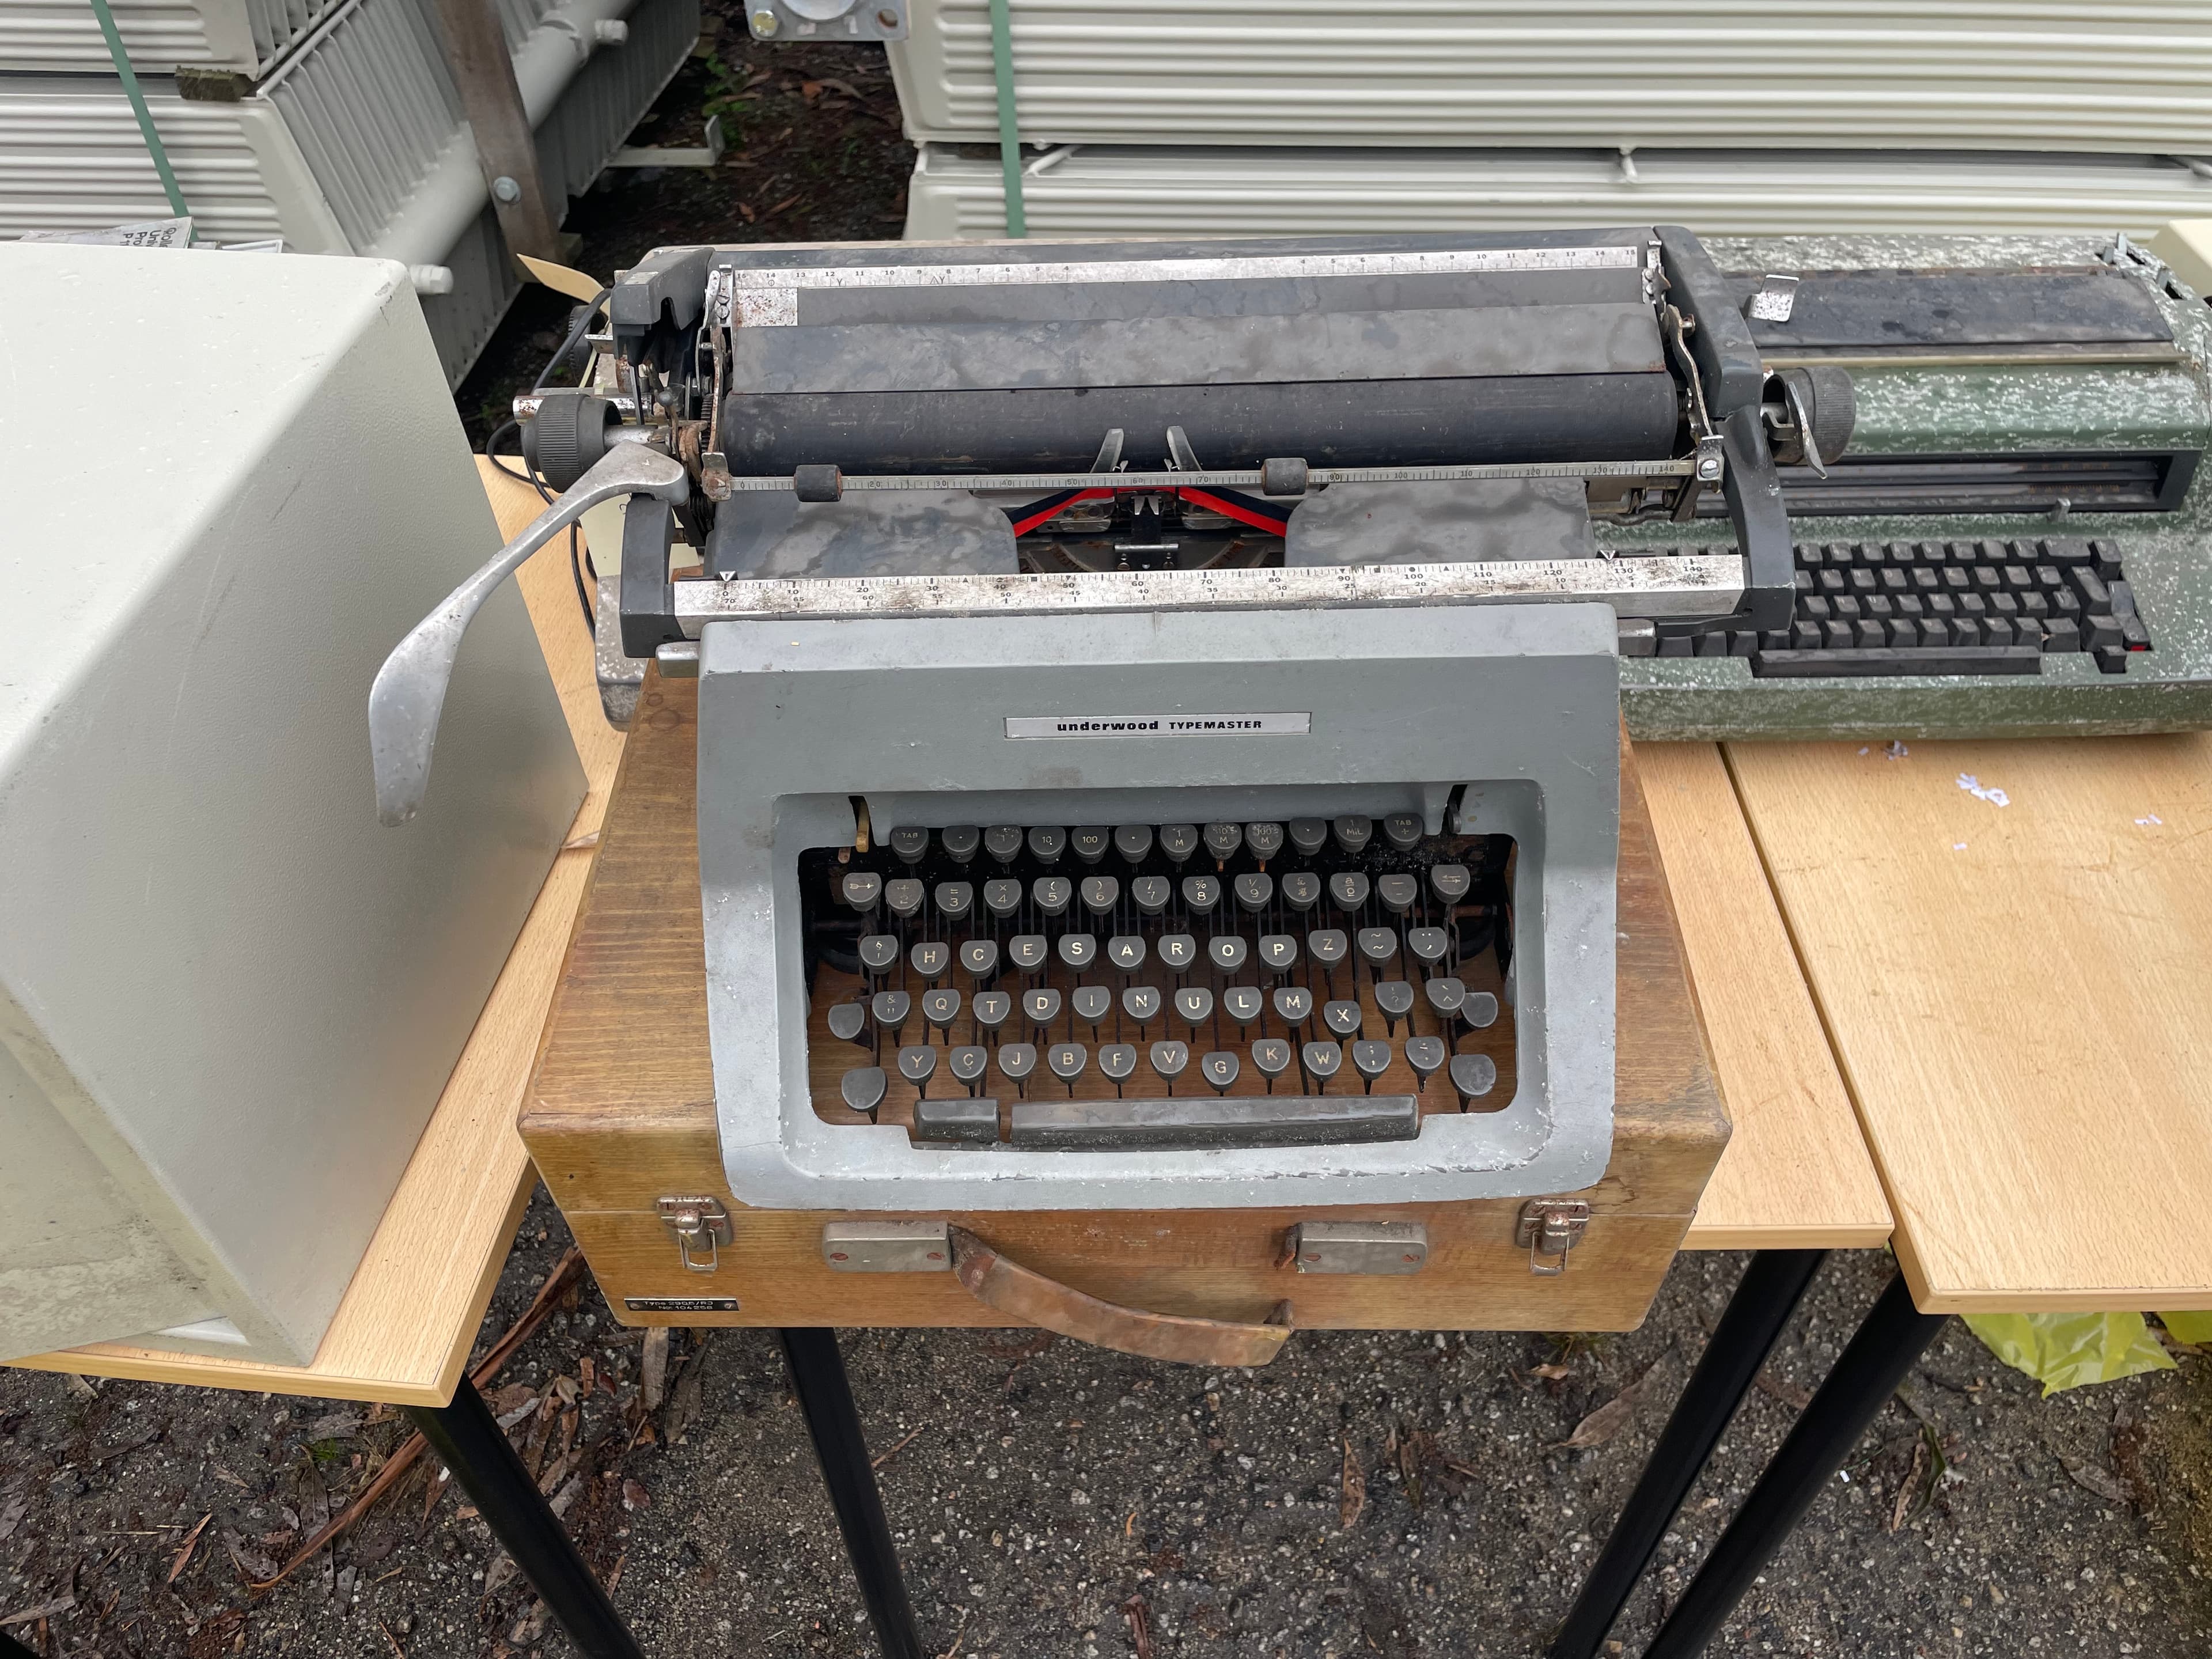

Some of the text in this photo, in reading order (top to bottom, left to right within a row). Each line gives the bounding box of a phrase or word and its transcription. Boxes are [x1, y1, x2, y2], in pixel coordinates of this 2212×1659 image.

[133, 232, 148, 247] Pro
[1057, 720, 1263, 732] underwood TYPEMASTER
[998, 894, 1007, 903] 4
[1048, 892, 1058, 901] 5
[1096, 892, 1104, 900] 6
[1147, 891, 1156, 900] 7
[1197, 892, 1206, 900] 8
[1250, 888, 1259, 898] 9
[950, 897, 959, 907] 3
[1023, 944, 1033, 956] E
[1071, 942, 1083, 955] S
[1121, 944, 1133, 956] A
[1171, 942, 1183, 955] R
[1273, 944, 1285, 956] P
[1323, 938, 1334, 950] Z
[924, 950, 936, 963] H
[972, 949, 984, 961] C
[1222, 944, 1234, 957] O
[887, 995, 896, 1003] &
[935, 998, 947, 1010] Q
[1037, 997, 1048, 1009] D
[1135, 995, 1147, 1007] N
[1188, 997, 1200, 1009] U
[1238, 995, 1249, 1008] L
[1286, 995, 1301, 1009] M
[986, 1001, 998, 1013] T
[1337, 1009, 1349, 1022] X
[1012, 1052, 1021, 1065] J
[1063, 1052, 1074, 1065] B
[1113, 1052, 1122, 1066] F
[1162, 1050, 1176, 1064] V
[1266, 1046, 1278, 1060] K
[1315, 1051, 1330, 1065] W
[911, 1055, 923, 1068] Y
[1214, 1060, 1227, 1074] G
